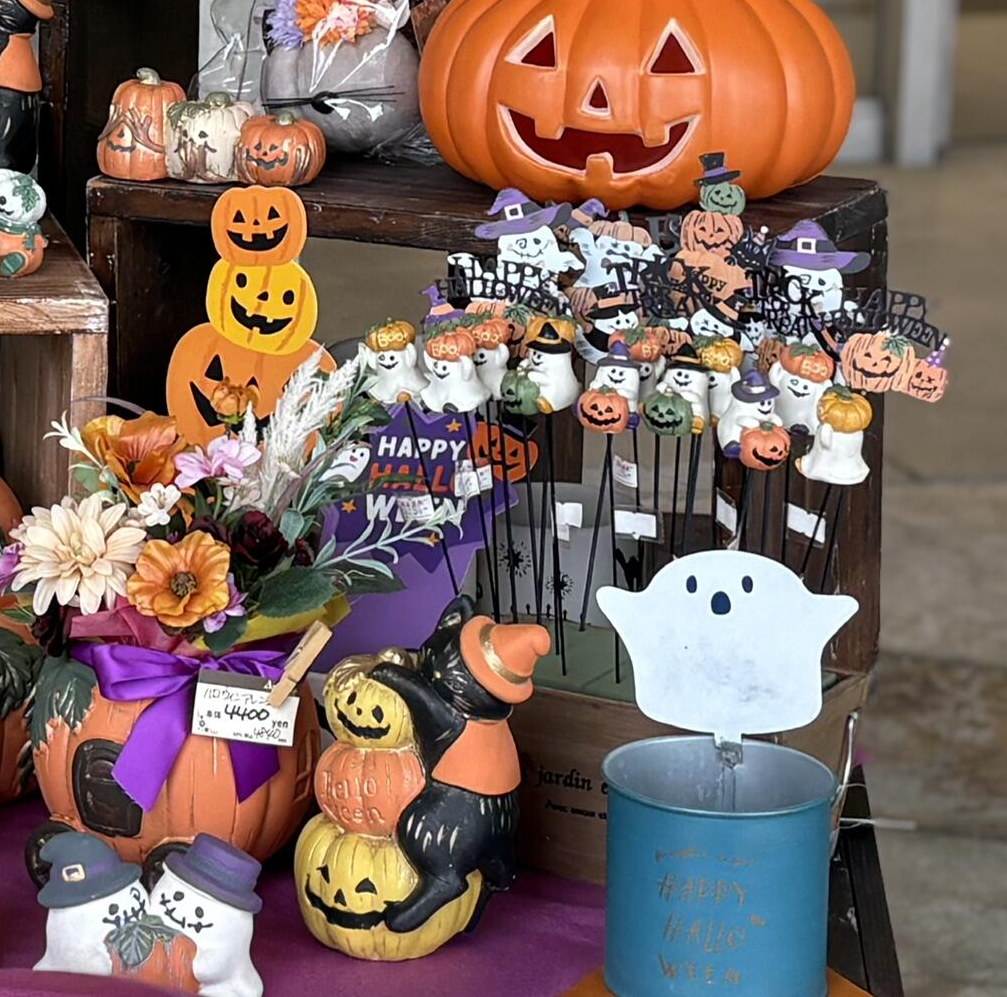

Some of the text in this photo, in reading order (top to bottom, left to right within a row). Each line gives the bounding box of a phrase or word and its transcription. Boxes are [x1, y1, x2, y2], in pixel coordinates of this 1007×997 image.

[377, 435, 466, 461] HAPPY
[224, 704, 270, 721] 4400
[272, 719, 289, 728] yen
[535, 765, 592, 791] jardin
